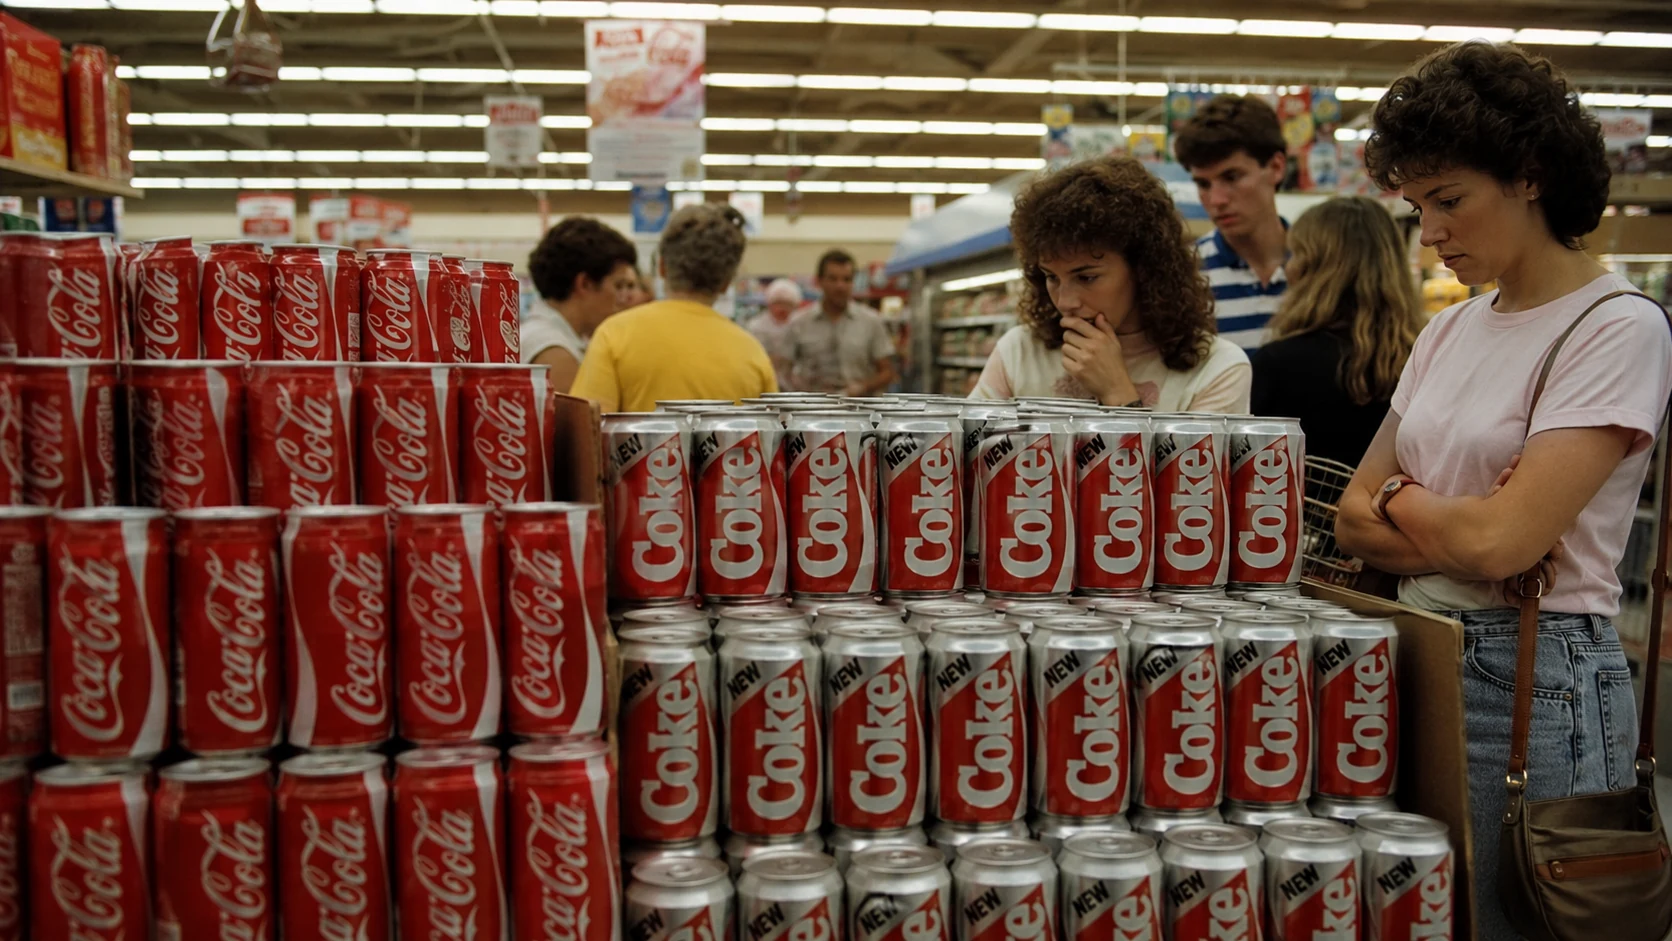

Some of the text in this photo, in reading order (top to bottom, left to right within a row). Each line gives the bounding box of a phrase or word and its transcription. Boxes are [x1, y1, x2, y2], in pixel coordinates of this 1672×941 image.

[885, 433, 918, 470] NEW
[983, 435, 1014, 471] NEW
[1076, 433, 1107, 470] NEW
[632, 447, 684, 582] Coke
[710, 446, 763, 580] Coke
[797, 447, 848, 578] Coke
[904, 448, 953, 577] Coke
[1000, 449, 1053, 578] Coke
[1093, 447, 1144, 574] Coke
[1164, 448, 1214, 571] Coke
[1238, 448, 1289, 569] Coke
[727, 661, 761, 700] NEW
[829, 657, 864, 696] NEW
[936, 653, 972, 692] NEW
[1043, 650, 1081, 688] NEW
[1142, 647, 1179, 683] NEW
[1225, 641, 1259, 677] NEW
[1317, 639, 1352, 675] NEW
[747, 676, 806, 820] Coke
[850, 673, 907, 814] Coke
[957, 669, 1014, 808] Coke
[1066, 665, 1120, 802] Coke
[1163, 660, 1216, 795] Coke
[1244, 656, 1299, 788] Coke
[1337, 654, 1389, 783] Coke
[641, 679, 699, 824] Coke
[963, 887, 1002, 926] NEW
[1072, 879, 1111, 918] NEW
[1170, 870, 1205, 908] NEW
[1280, 864, 1320, 901] NEW
[1377, 857, 1418, 895] NEW
[1410, 869, 1450, 941] ke
[749, 903, 785, 941] NEW
[1199, 885, 1249, 941] ke
[1312, 877, 1357, 941] ke
